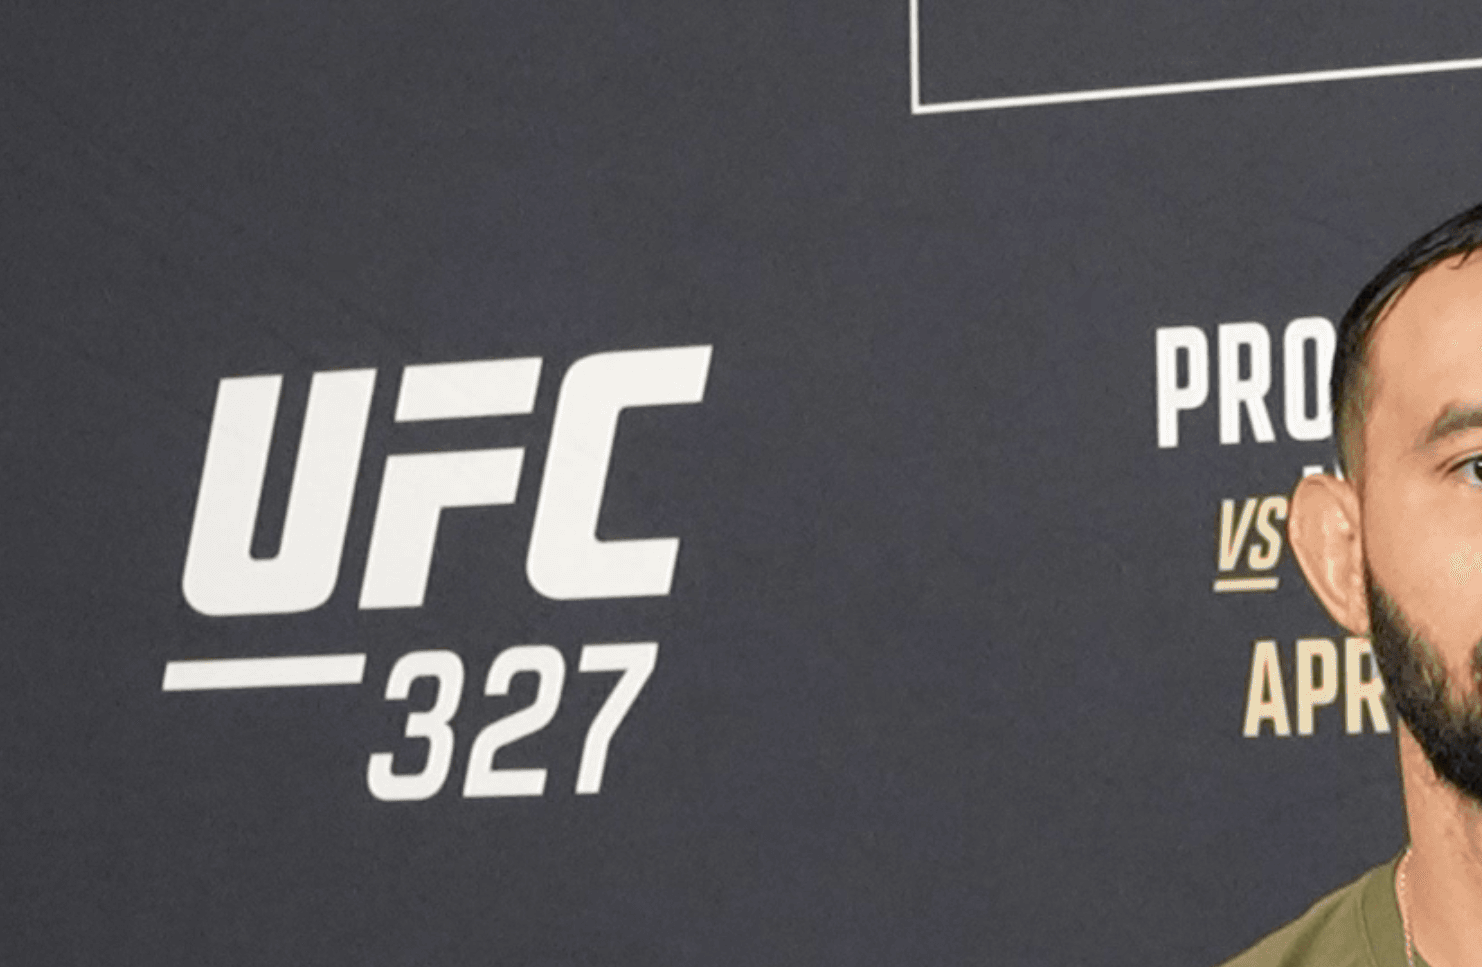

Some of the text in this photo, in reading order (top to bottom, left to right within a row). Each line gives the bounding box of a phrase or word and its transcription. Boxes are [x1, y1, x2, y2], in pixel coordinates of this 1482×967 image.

[181, 344, 713, 617] UFC
[1218, 496, 1288, 571] VS
[367, 642, 658, 801] 327
[1243, 637, 1391, 737] APR
